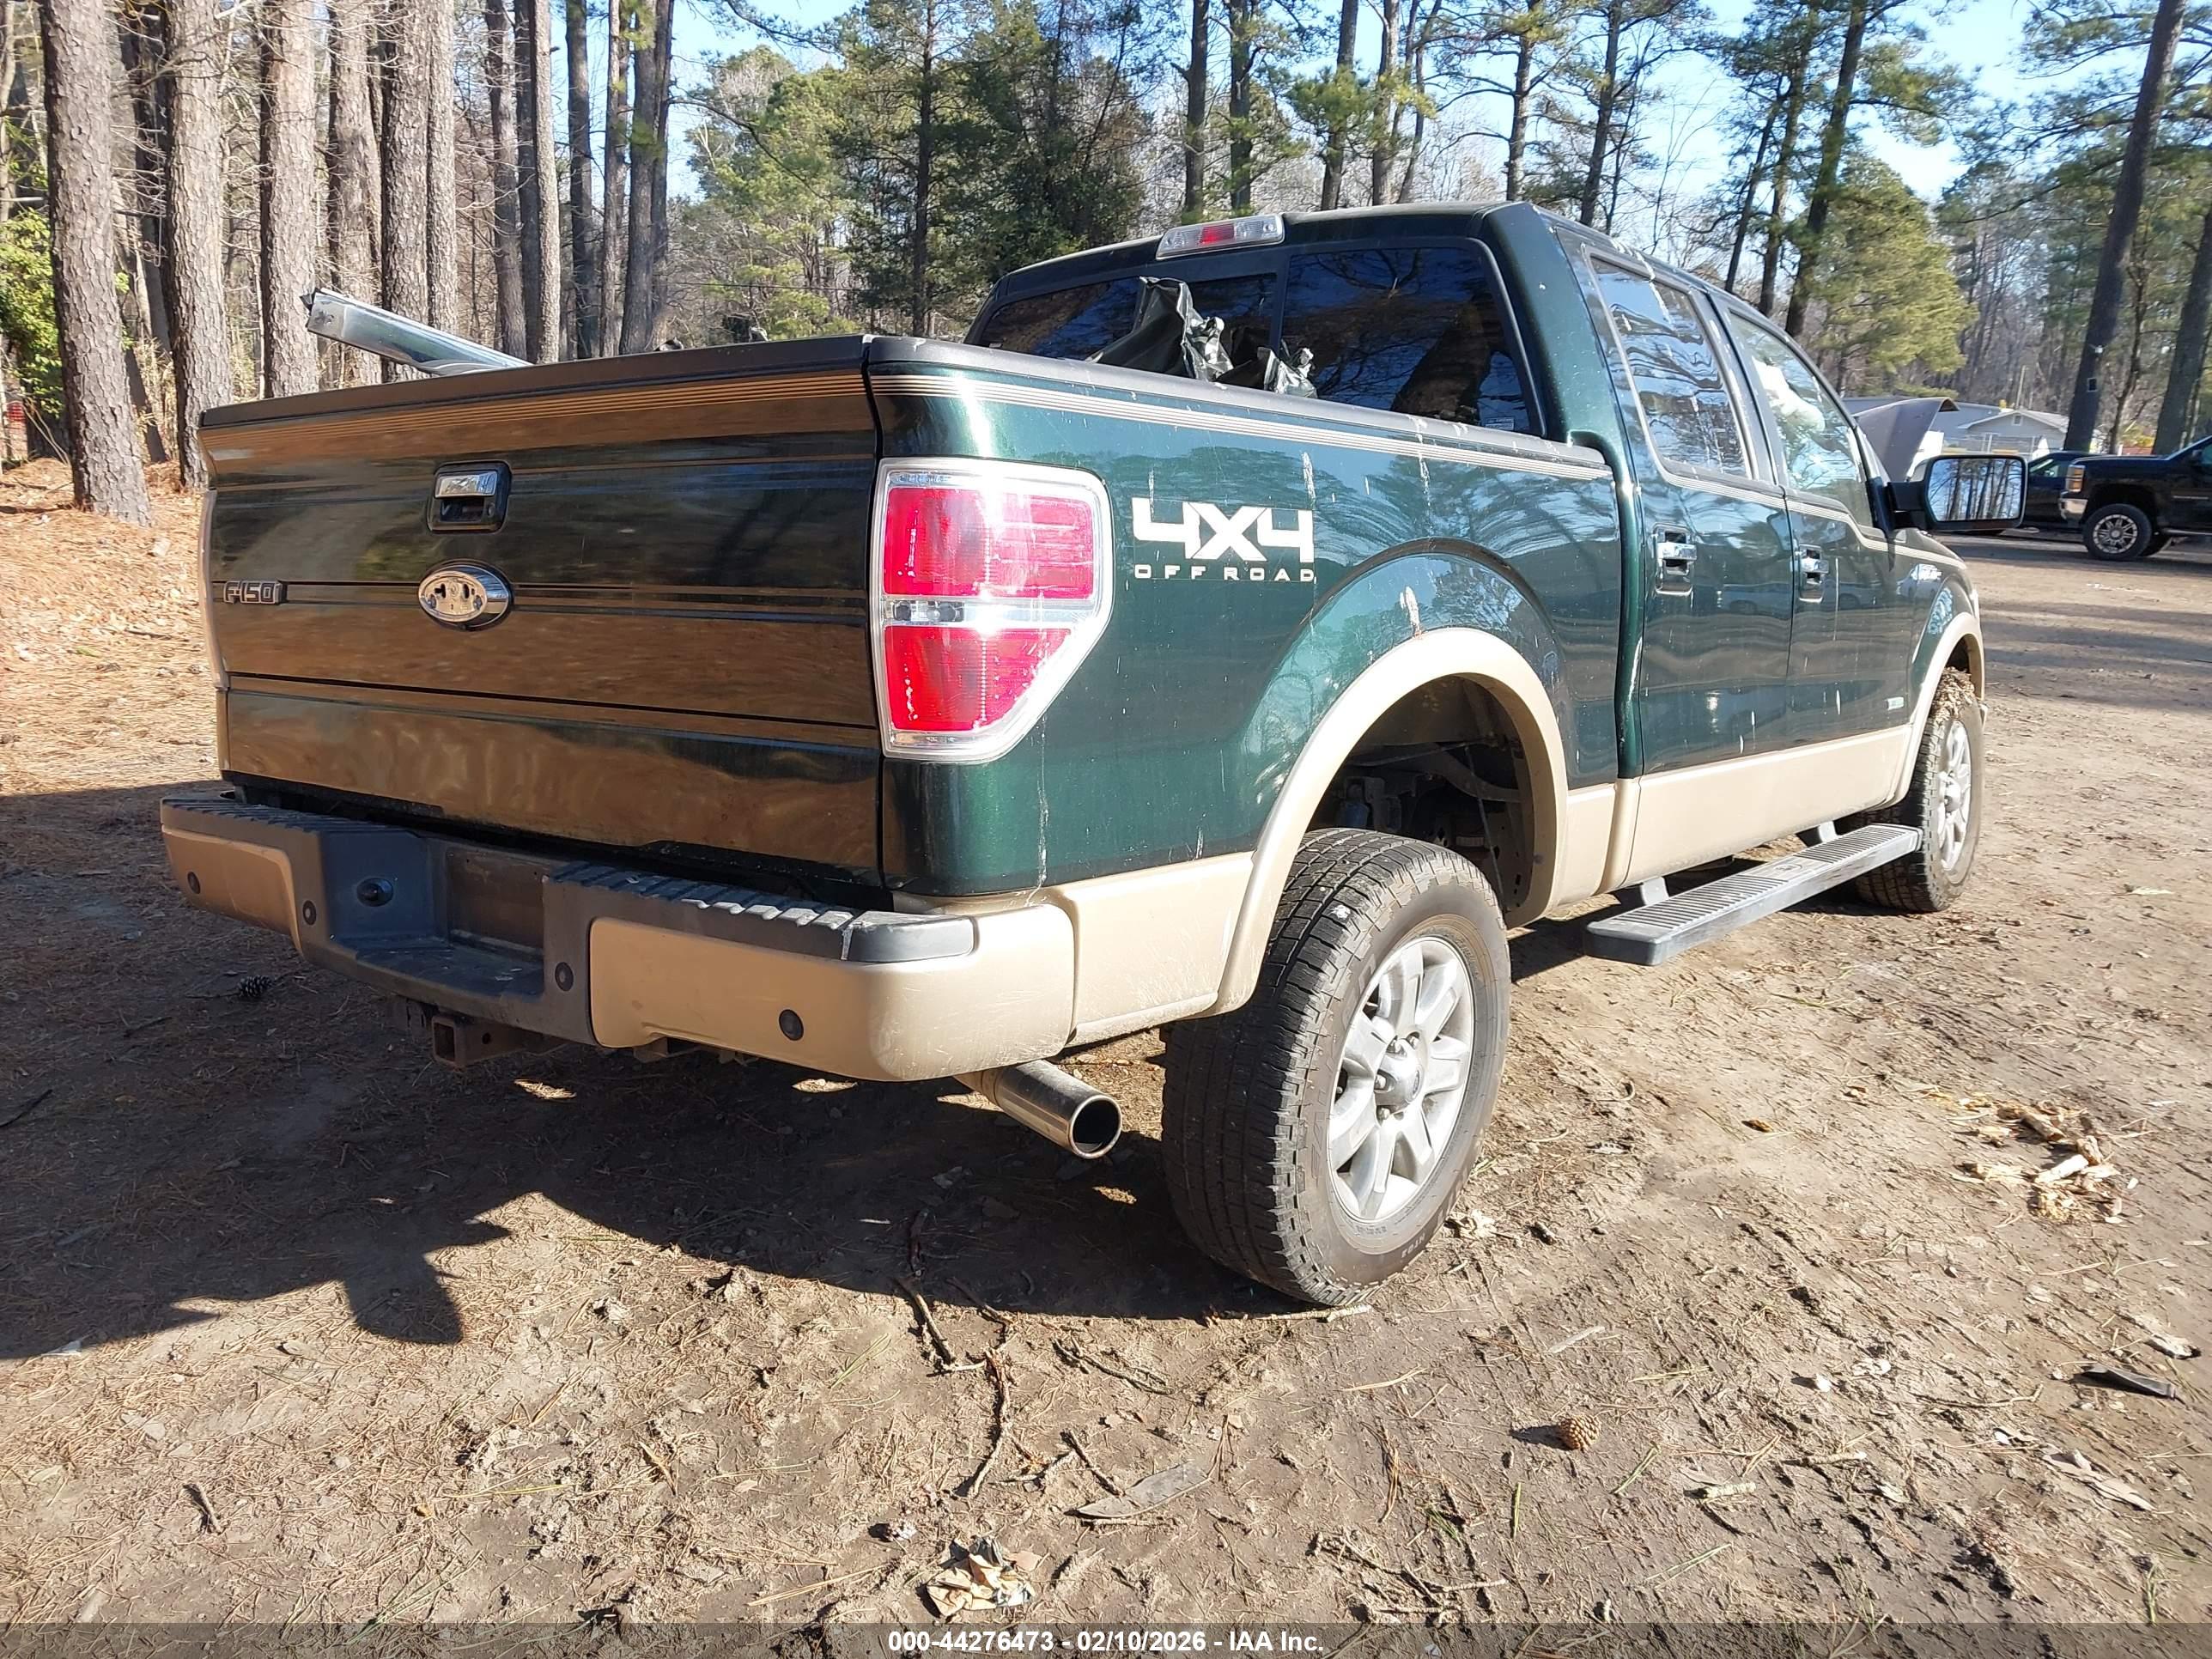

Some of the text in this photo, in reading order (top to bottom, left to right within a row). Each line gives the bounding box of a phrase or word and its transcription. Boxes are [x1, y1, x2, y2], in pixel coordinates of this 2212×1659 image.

[1131, 496, 1315, 563] 4X4
[1134, 564, 1314, 582] OFF ROAD
[224, 580, 279, 605] F-150
